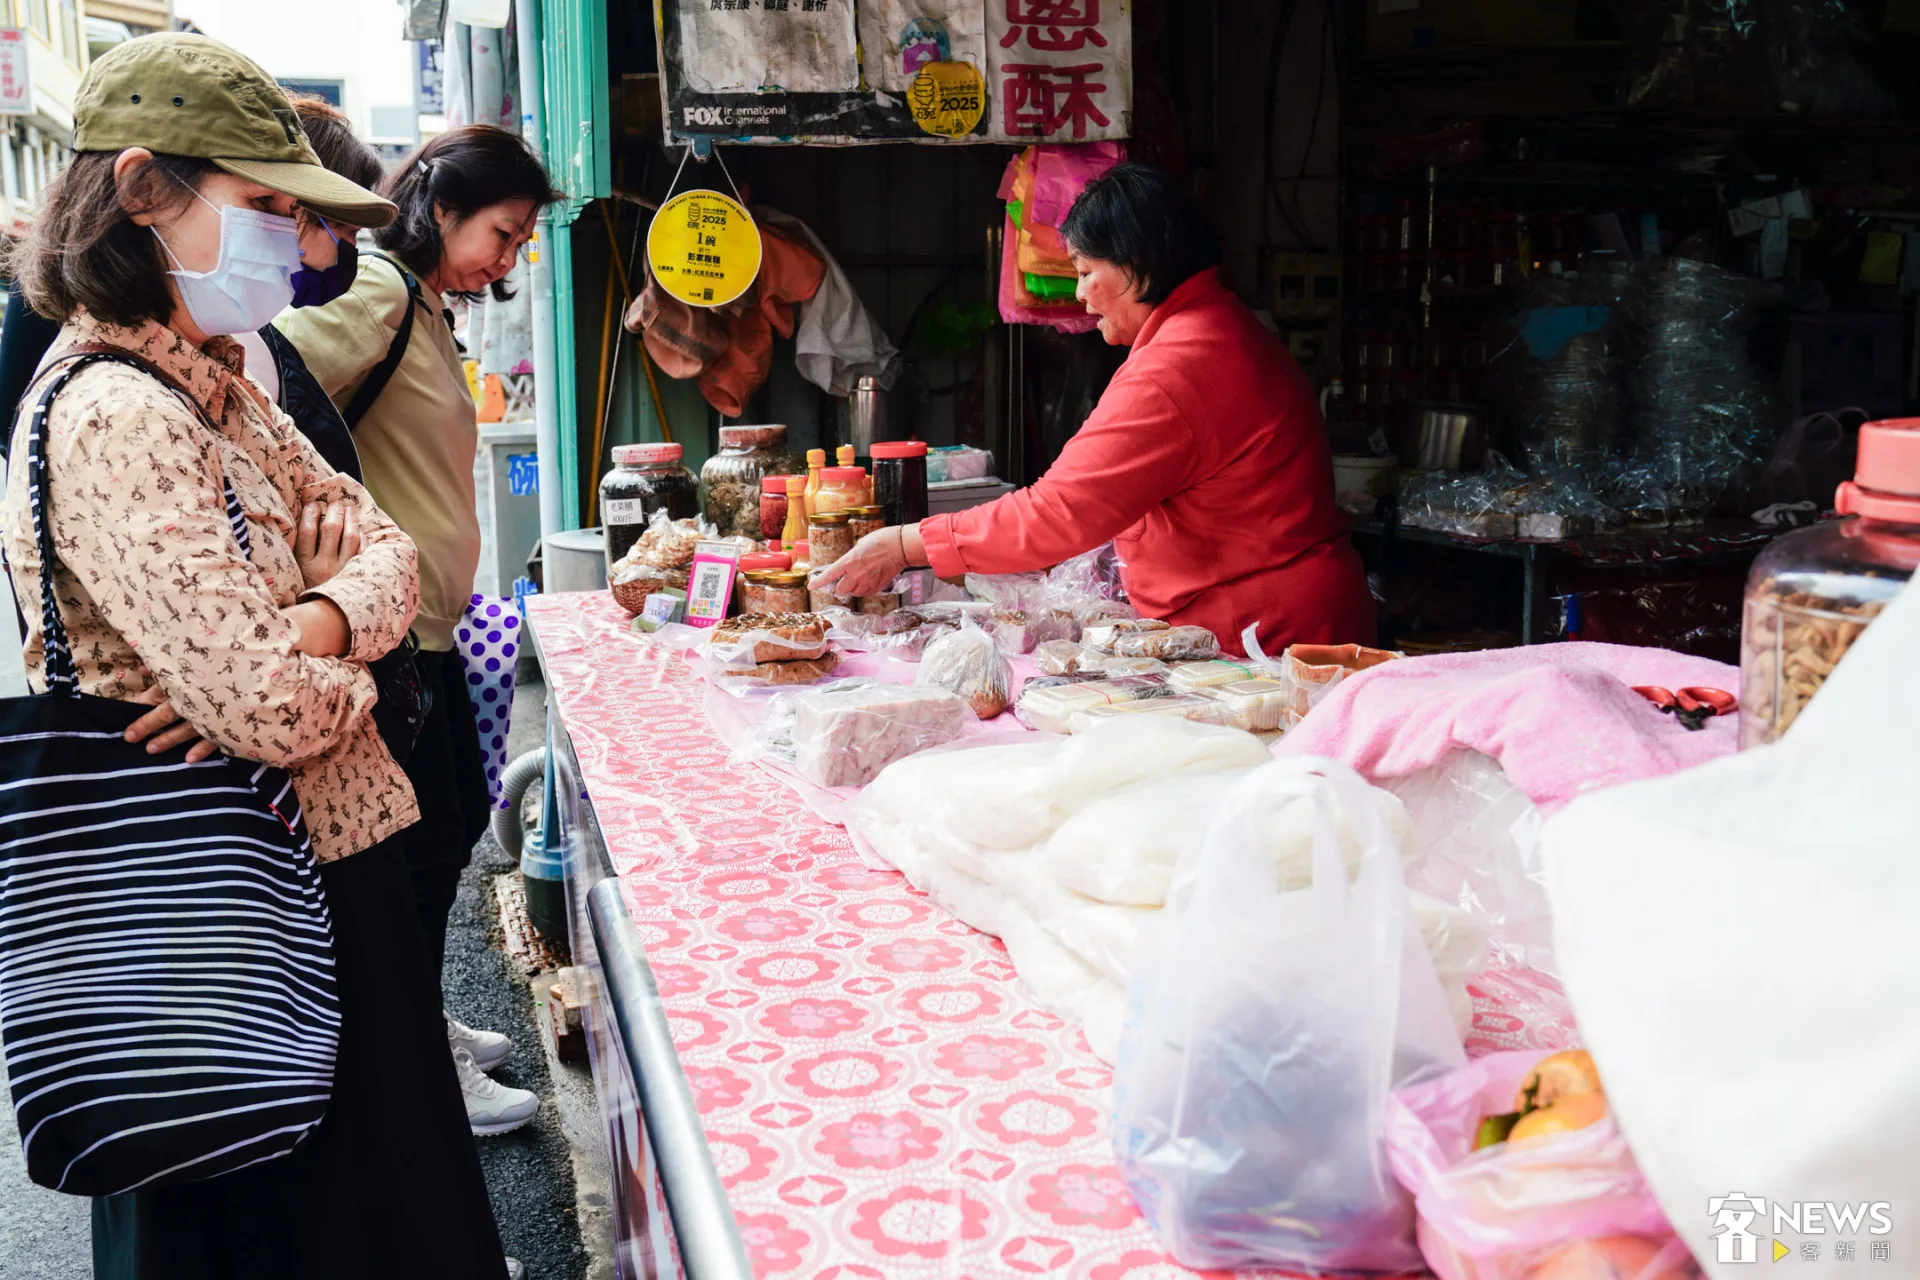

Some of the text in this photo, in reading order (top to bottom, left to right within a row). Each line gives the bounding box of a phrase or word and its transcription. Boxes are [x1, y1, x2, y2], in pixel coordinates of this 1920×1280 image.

[940, 97, 979, 112] 2025
[683, 105, 787, 127] FOX Inernational
[702, 214, 727, 226] 2025
